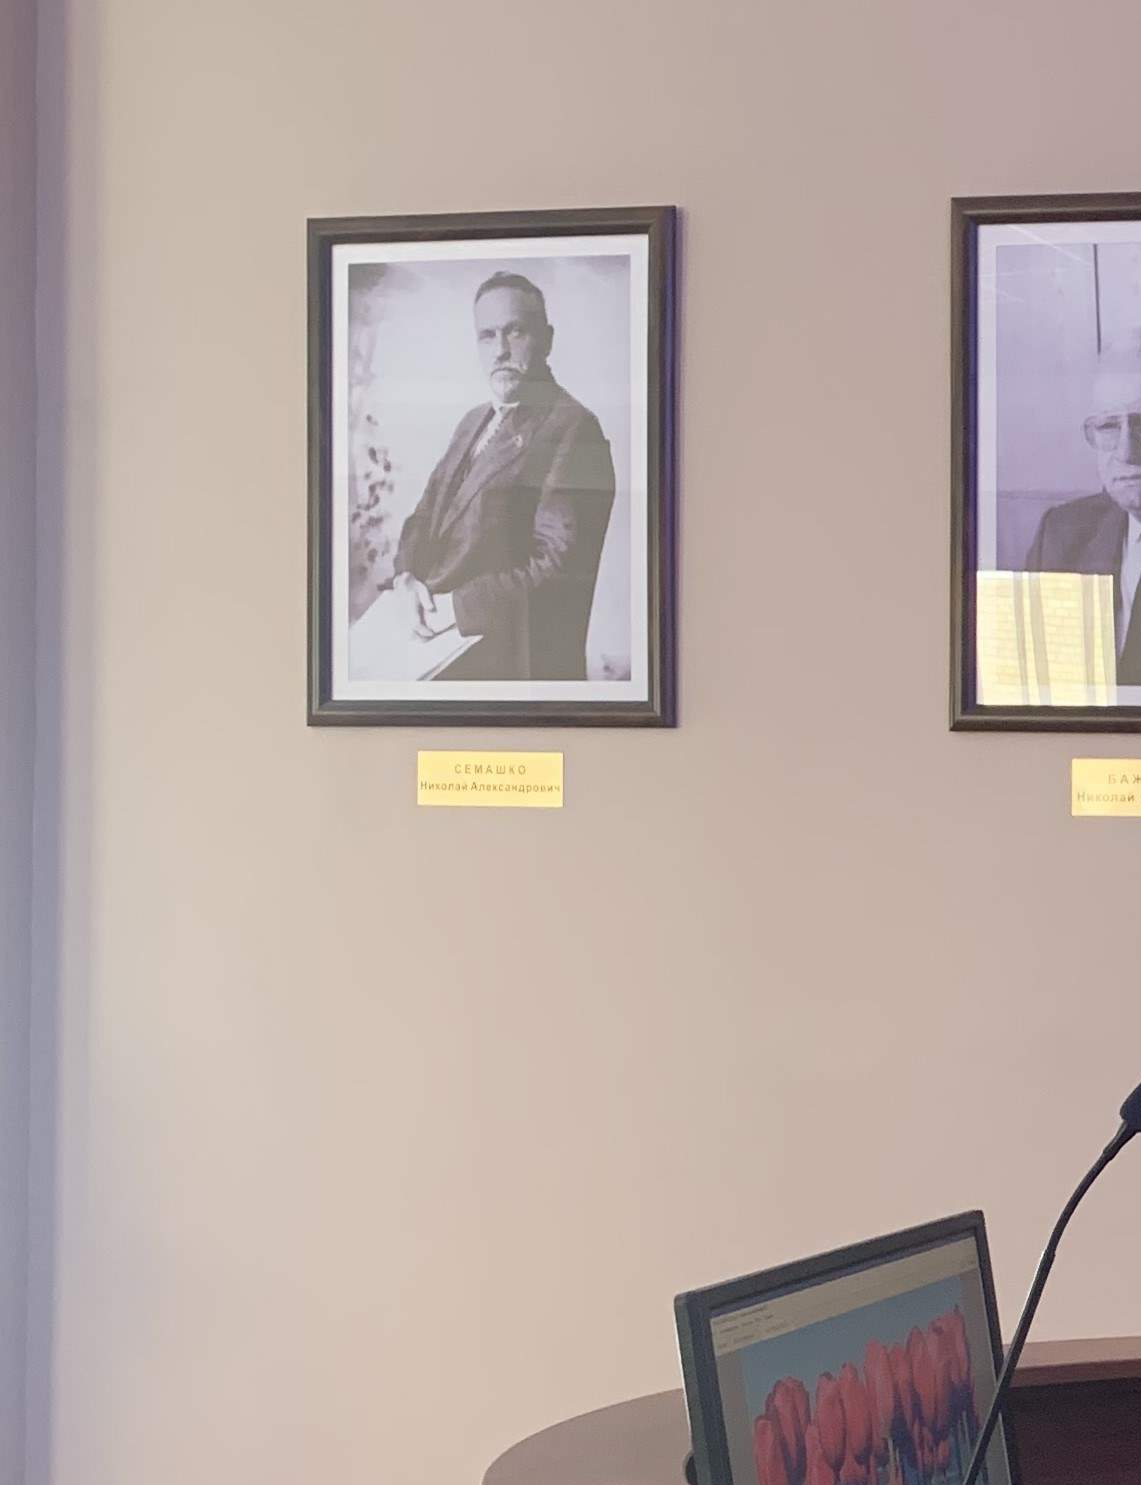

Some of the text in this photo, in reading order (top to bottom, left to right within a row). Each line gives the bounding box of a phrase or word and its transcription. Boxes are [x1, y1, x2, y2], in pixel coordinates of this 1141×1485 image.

[454, 764, 527, 775] СЕМАШКО
[420, 781, 561, 793] Николай Александрович
[1077, 791, 1135, 802] Николай
